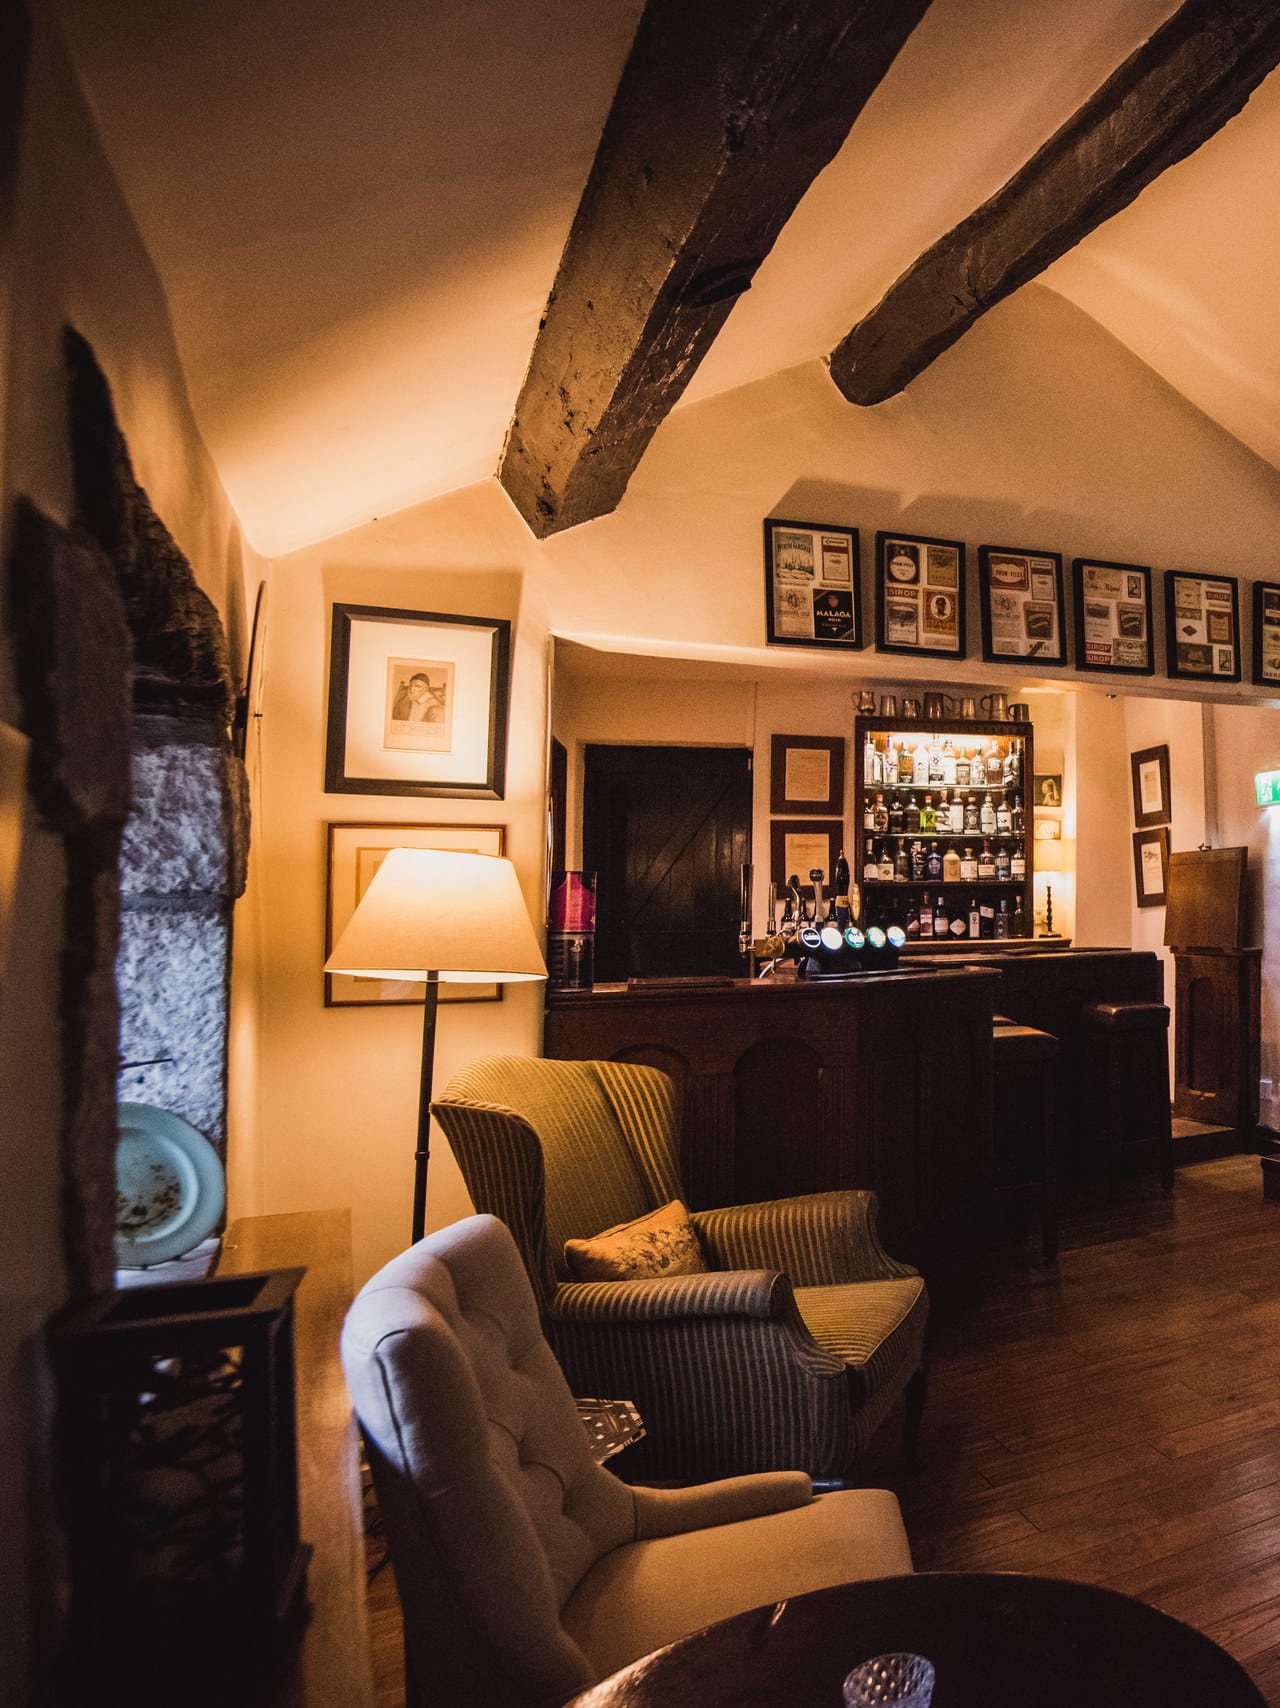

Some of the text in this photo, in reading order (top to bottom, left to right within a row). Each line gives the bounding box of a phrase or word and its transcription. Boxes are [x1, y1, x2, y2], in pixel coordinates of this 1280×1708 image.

[889, 589, 916, 598] SIROP
[816, 610, 851, 618] MALAGA
[1086, 643, 1110, 652] SIROP
[1086, 654, 1110, 663] SIROP
